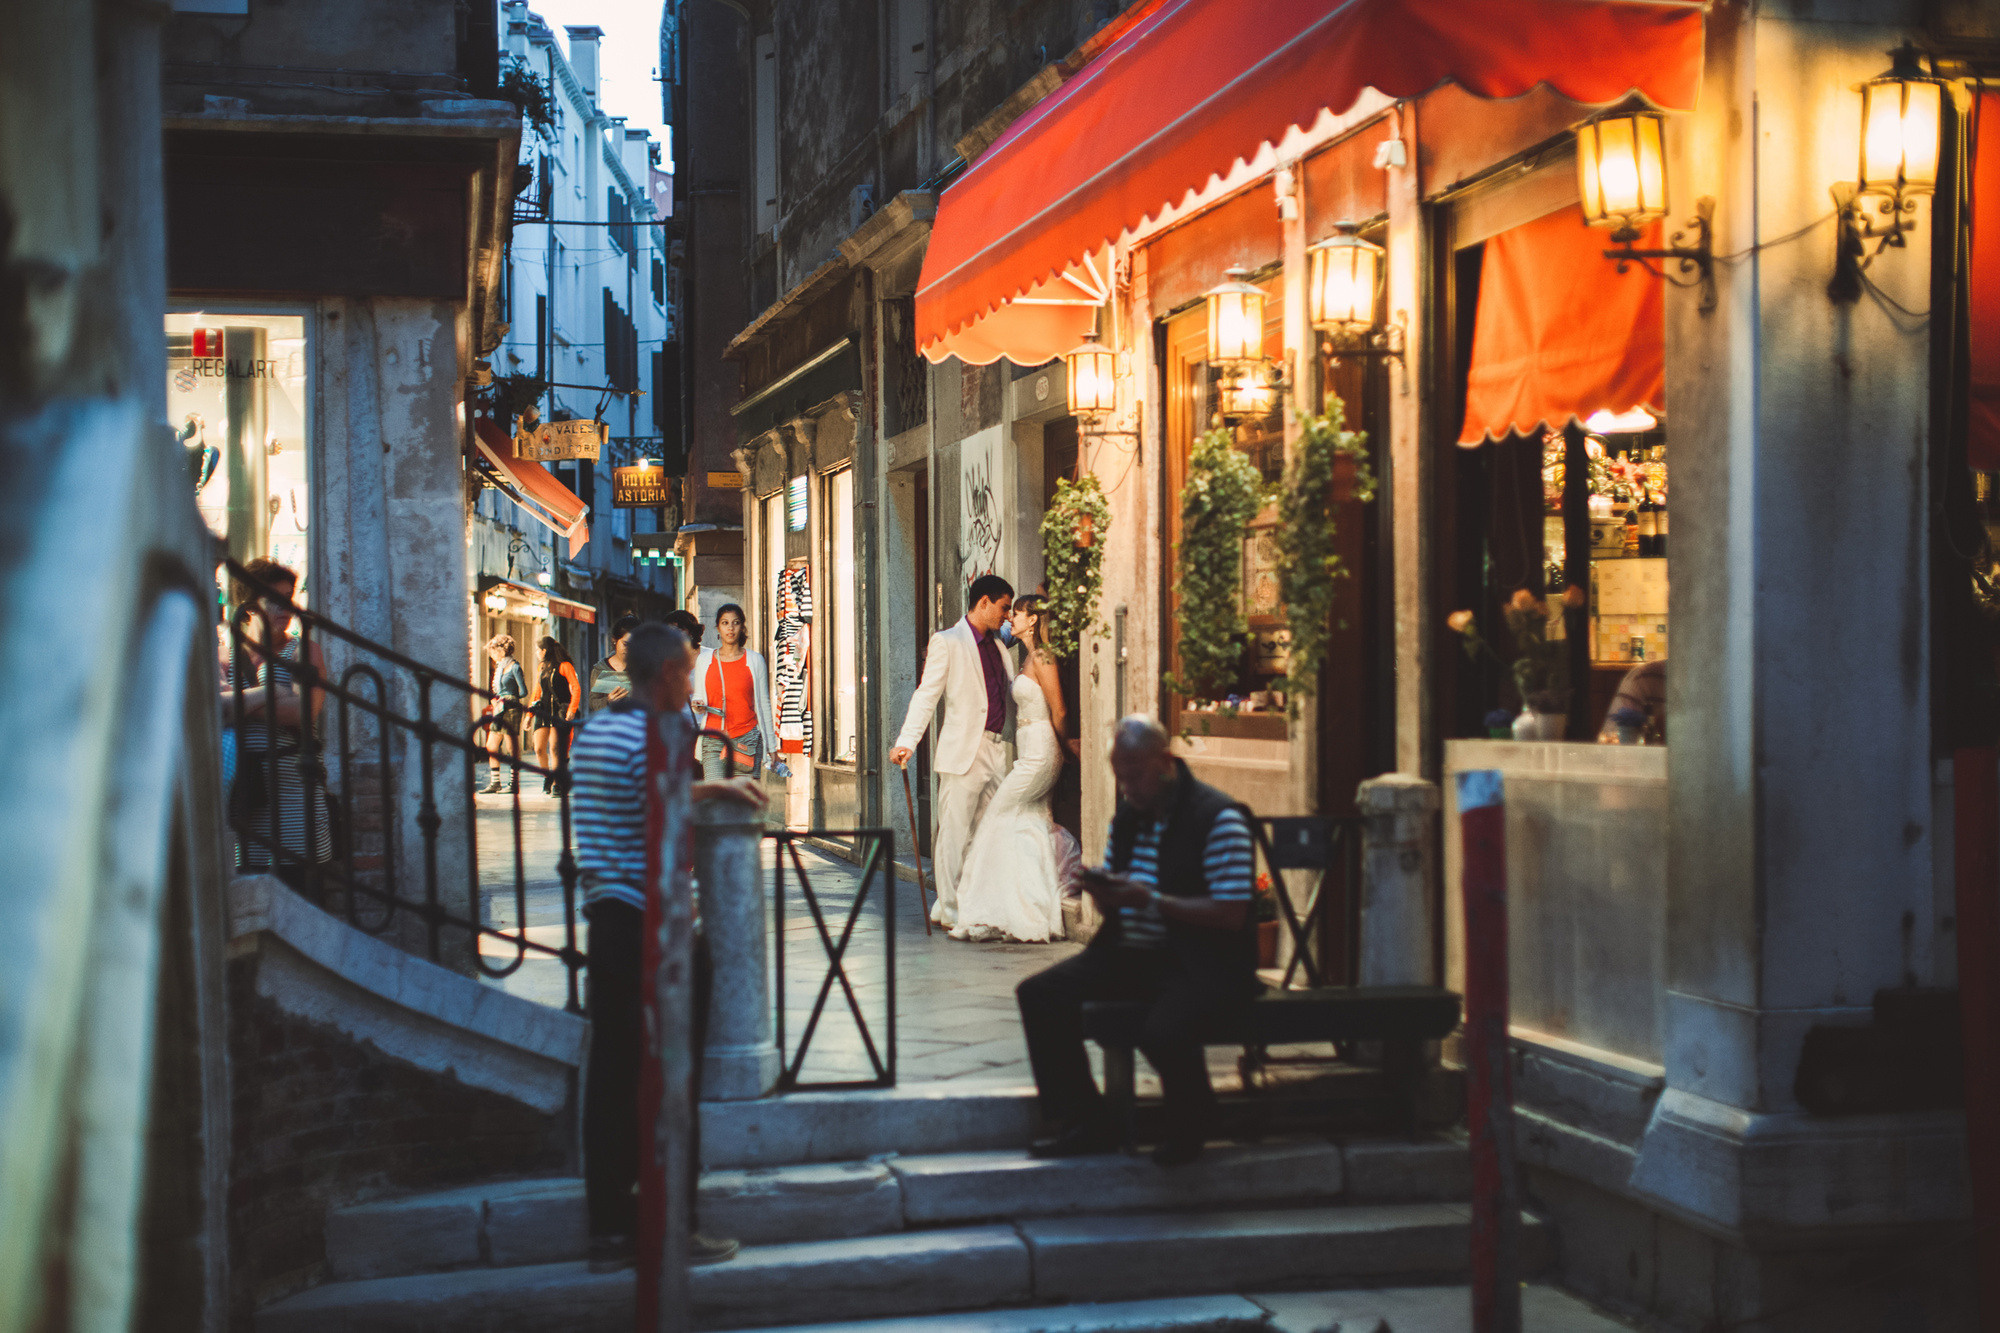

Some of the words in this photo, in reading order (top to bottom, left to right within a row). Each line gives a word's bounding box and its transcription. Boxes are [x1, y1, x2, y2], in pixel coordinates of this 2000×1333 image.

[192, 358, 278, 379] REGALART
[622, 473, 661, 487] HOTEL
[617, 489, 667, 502] ASTORIA
